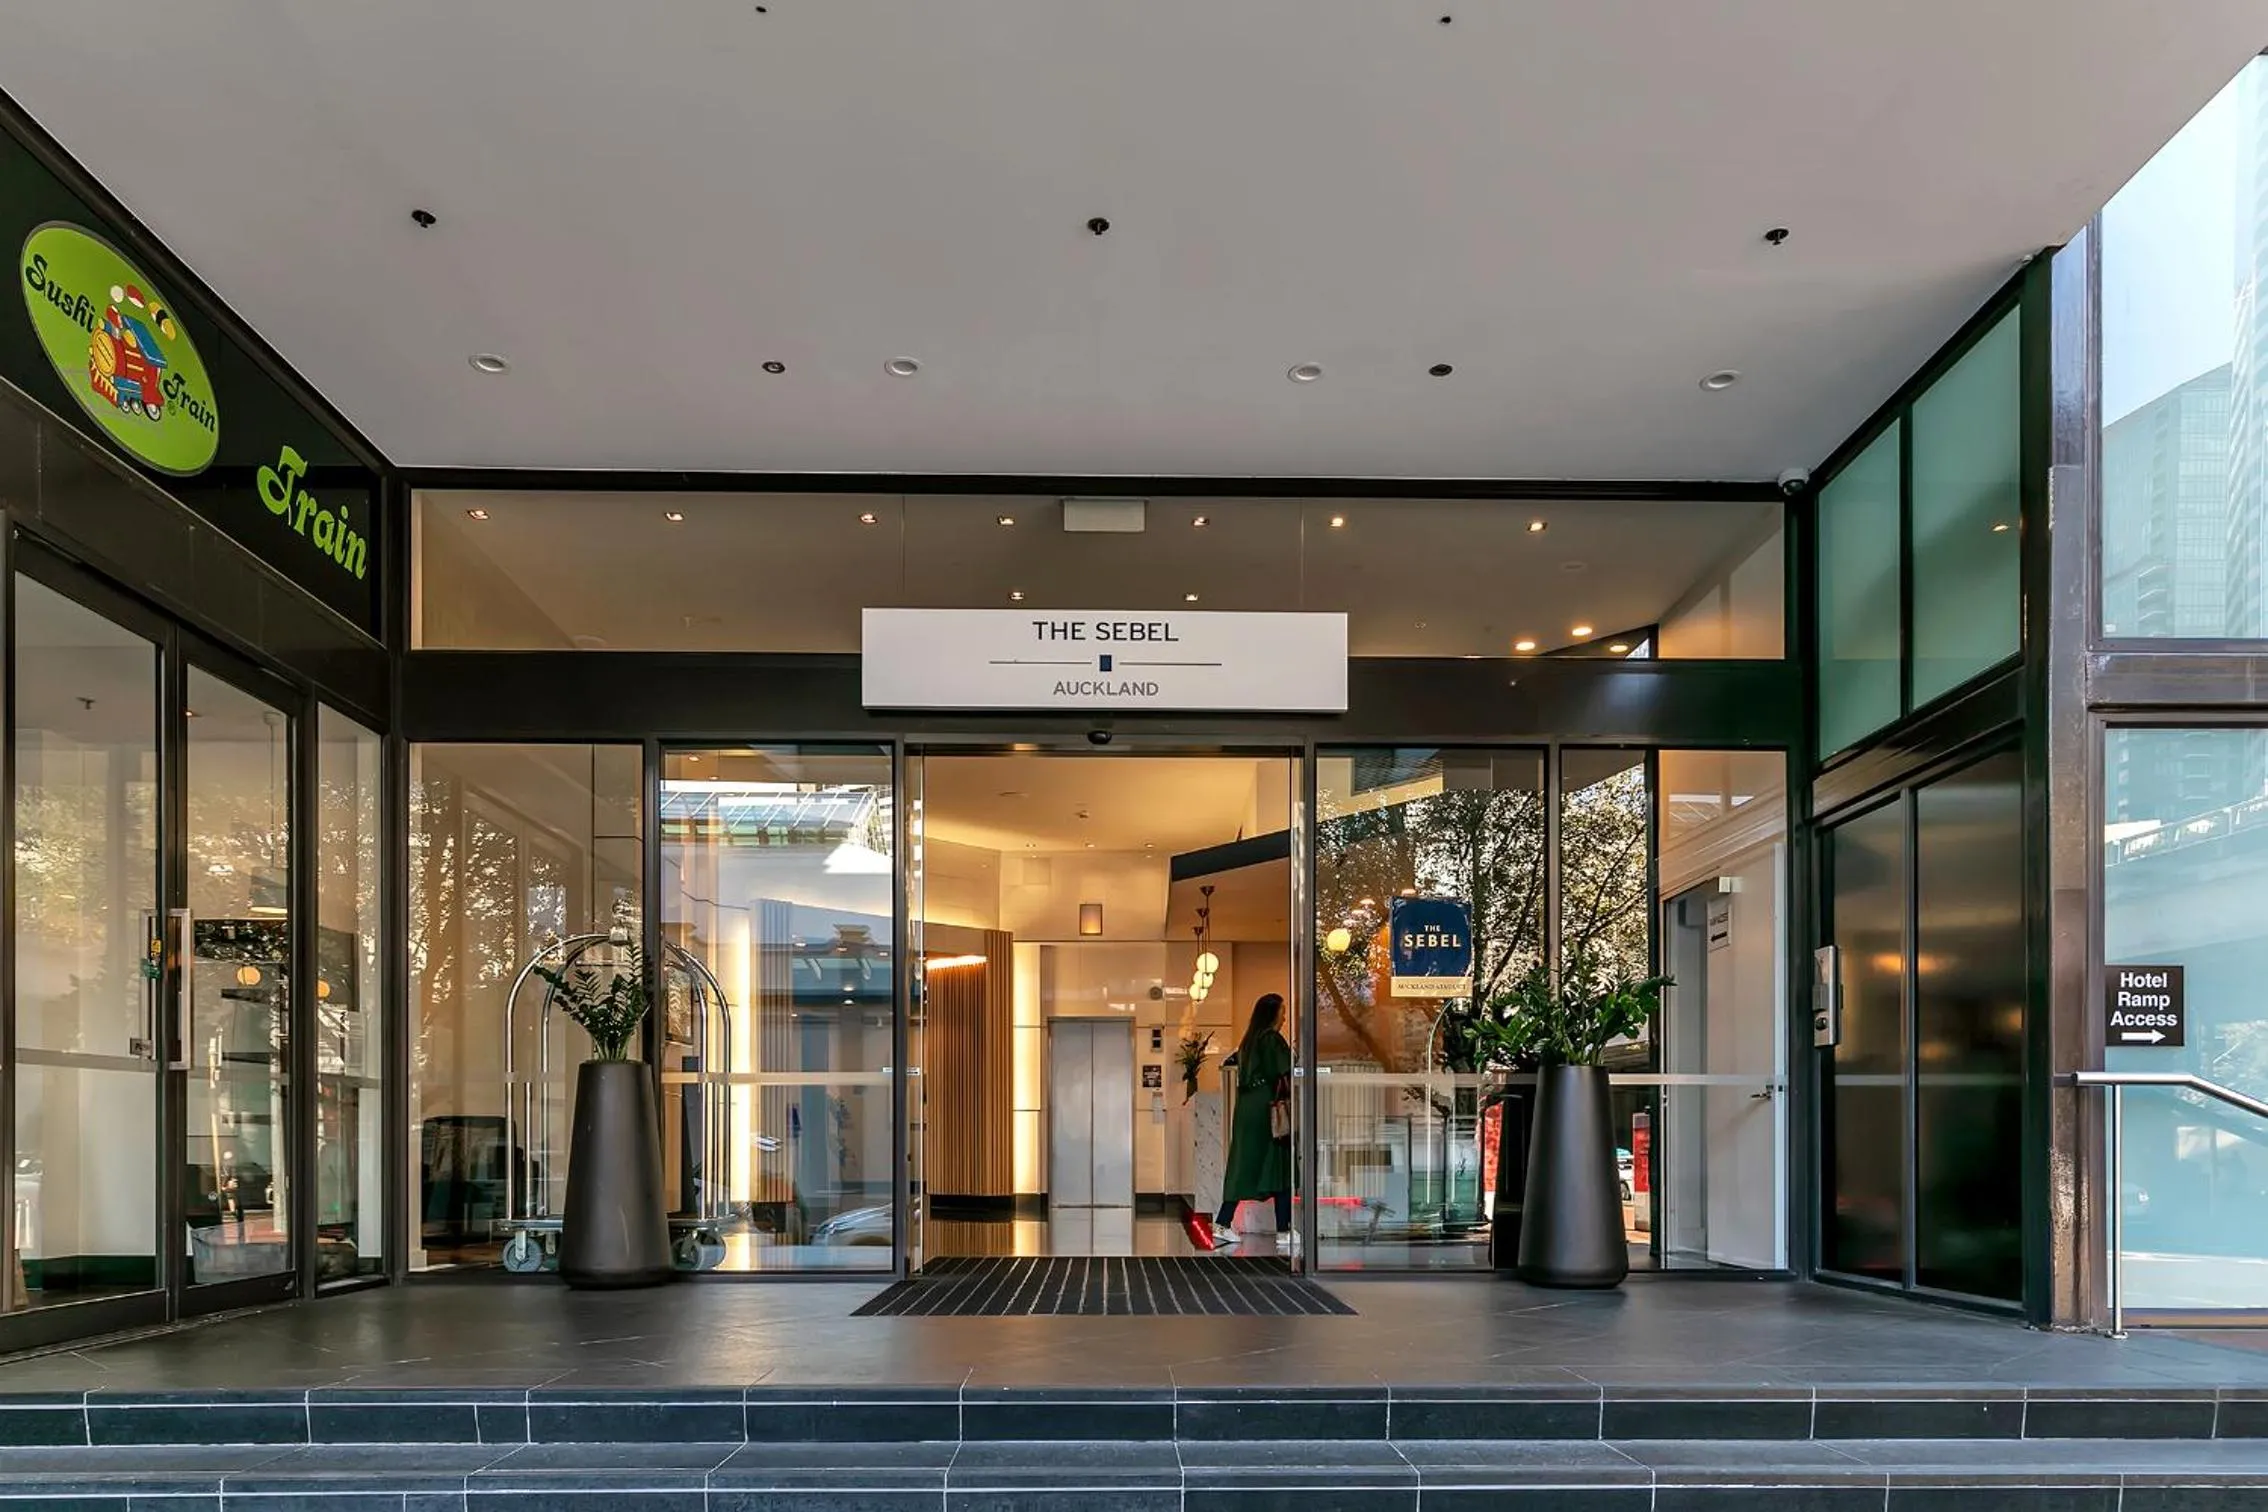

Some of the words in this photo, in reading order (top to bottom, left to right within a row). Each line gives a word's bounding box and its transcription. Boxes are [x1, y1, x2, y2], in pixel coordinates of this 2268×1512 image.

[25, 253, 96, 334] Sushi
[163, 373, 216, 432] Train
[256, 446, 367, 579] Train
[1032, 621, 1086, 640] THE
[1095, 622, 1179, 642] SEBEL
[1053, 681, 1160, 697] AUCKLAND
[1424, 924, 1441, 932] THE
[1404, 934, 1461, 948] SEBEL
[2120, 972, 2168, 988] Hotel
[2117, 991, 2171, 1011] Ramp
[2110, 1011, 2178, 1026] Access
